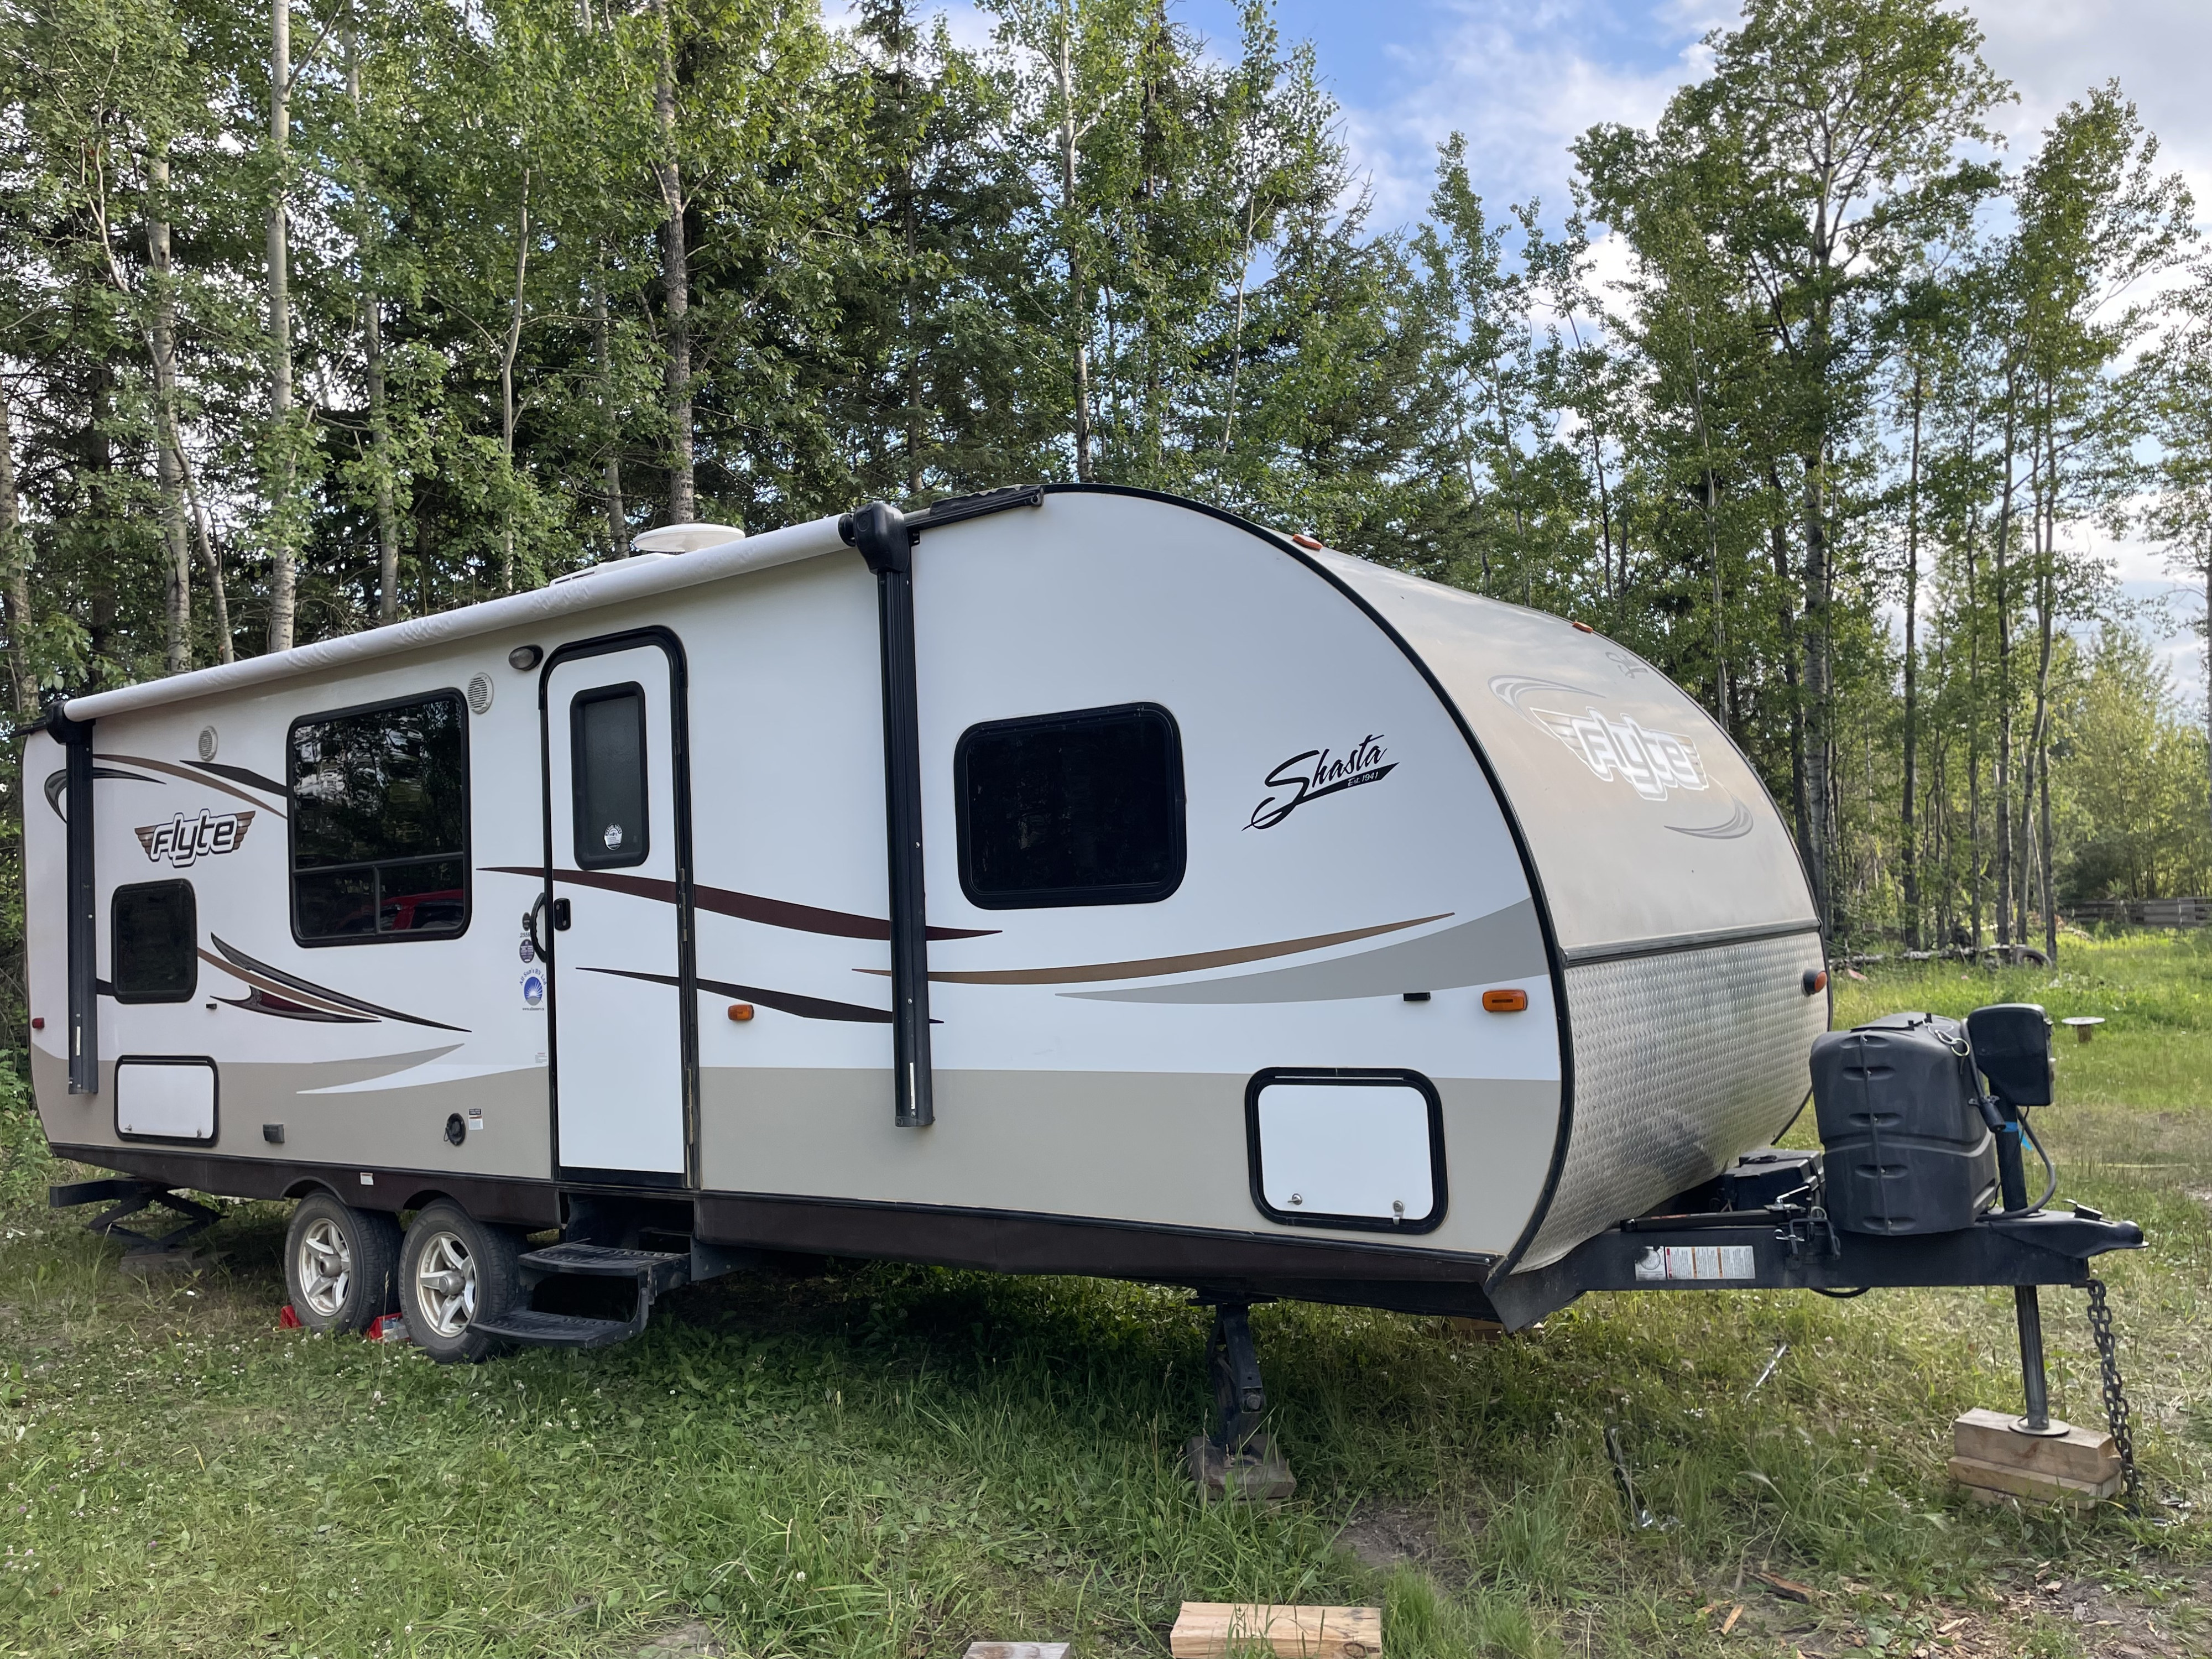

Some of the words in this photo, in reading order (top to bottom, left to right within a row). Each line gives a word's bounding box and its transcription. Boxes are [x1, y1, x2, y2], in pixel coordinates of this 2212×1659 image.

[1242, 734, 1387, 831] Shasta
[1348, 778, 1360, 786] Est.
[1362, 771, 1379, 782] 1941
[151, 811, 238, 865] Flyte
